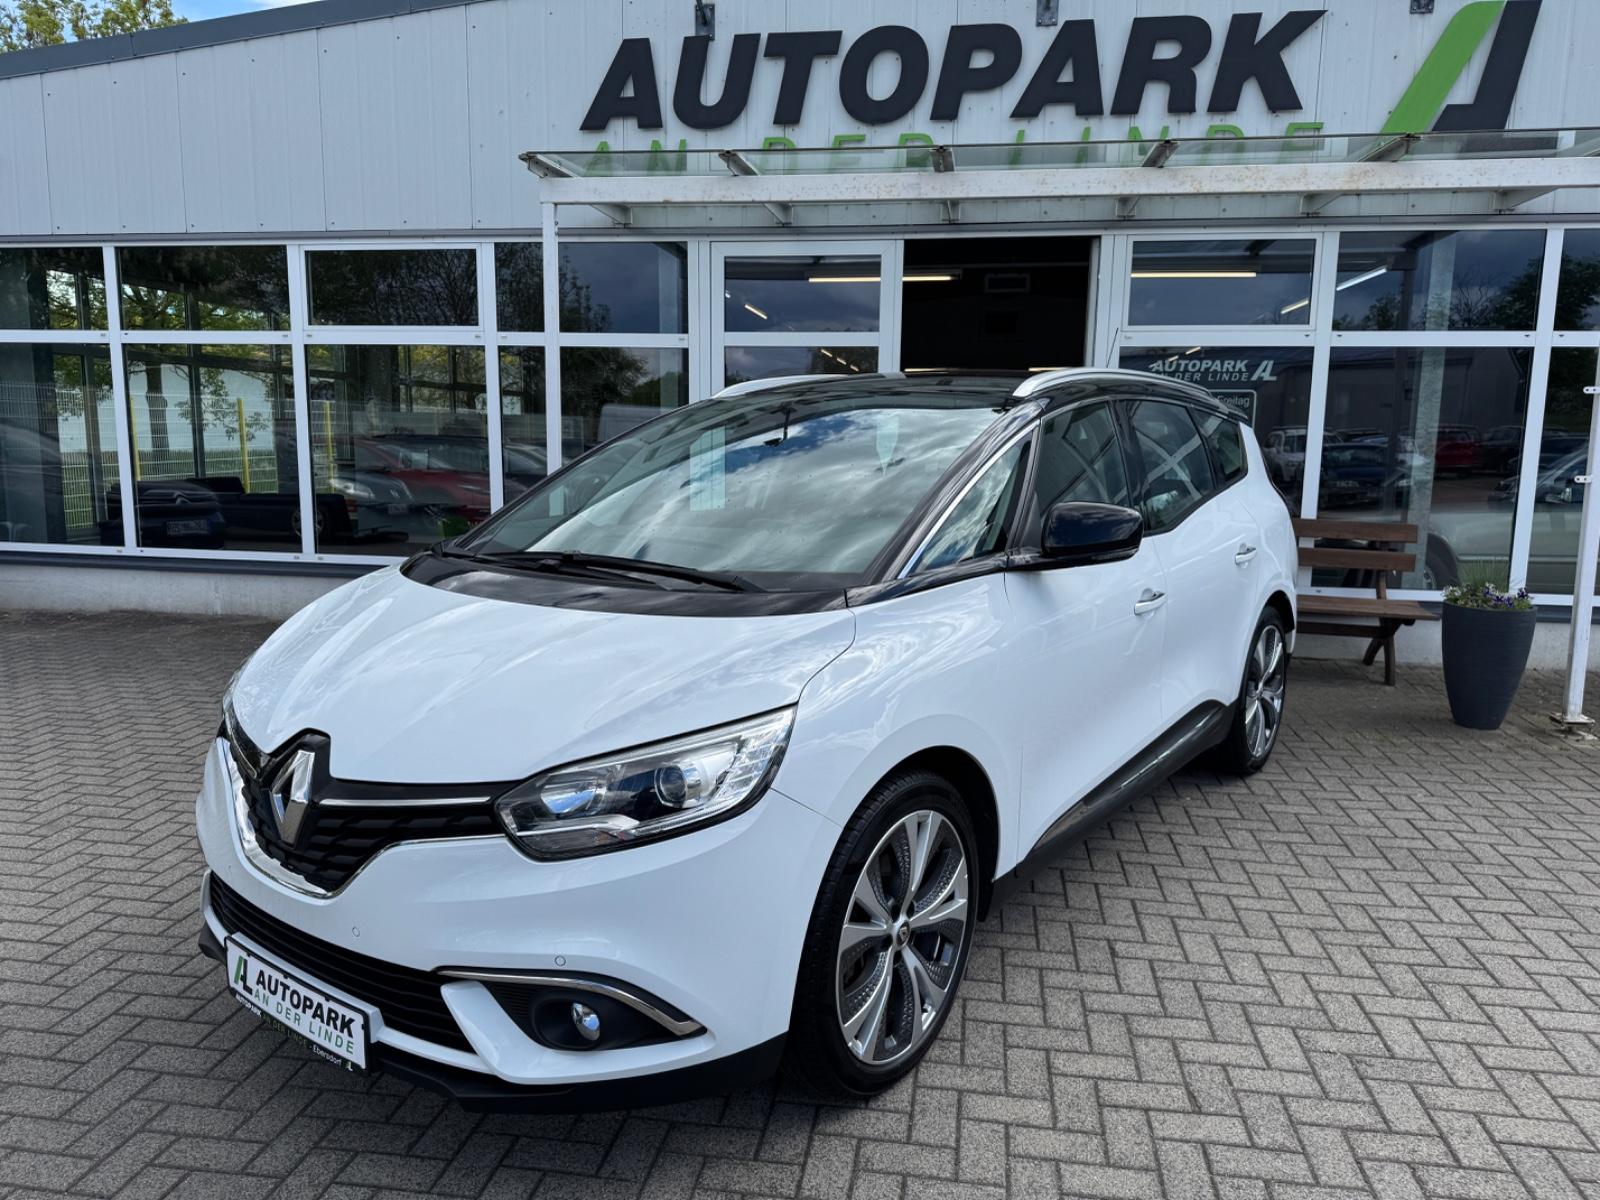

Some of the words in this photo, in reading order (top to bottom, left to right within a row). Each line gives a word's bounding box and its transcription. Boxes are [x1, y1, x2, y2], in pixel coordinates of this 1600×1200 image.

[581, 11, 1325, 131] AUTOPARK
[1151, 360, 1249, 372] AUTOPARK
[1174, 372, 1201, 381] DER
[1208, 372, 1249, 381] LINDE
[253, 988, 269, 1007] AN
[276, 1003, 301, 1027] DER
[308, 1021, 355, 1055] LINDE
[256, 969, 356, 1039] AUTOPARK
